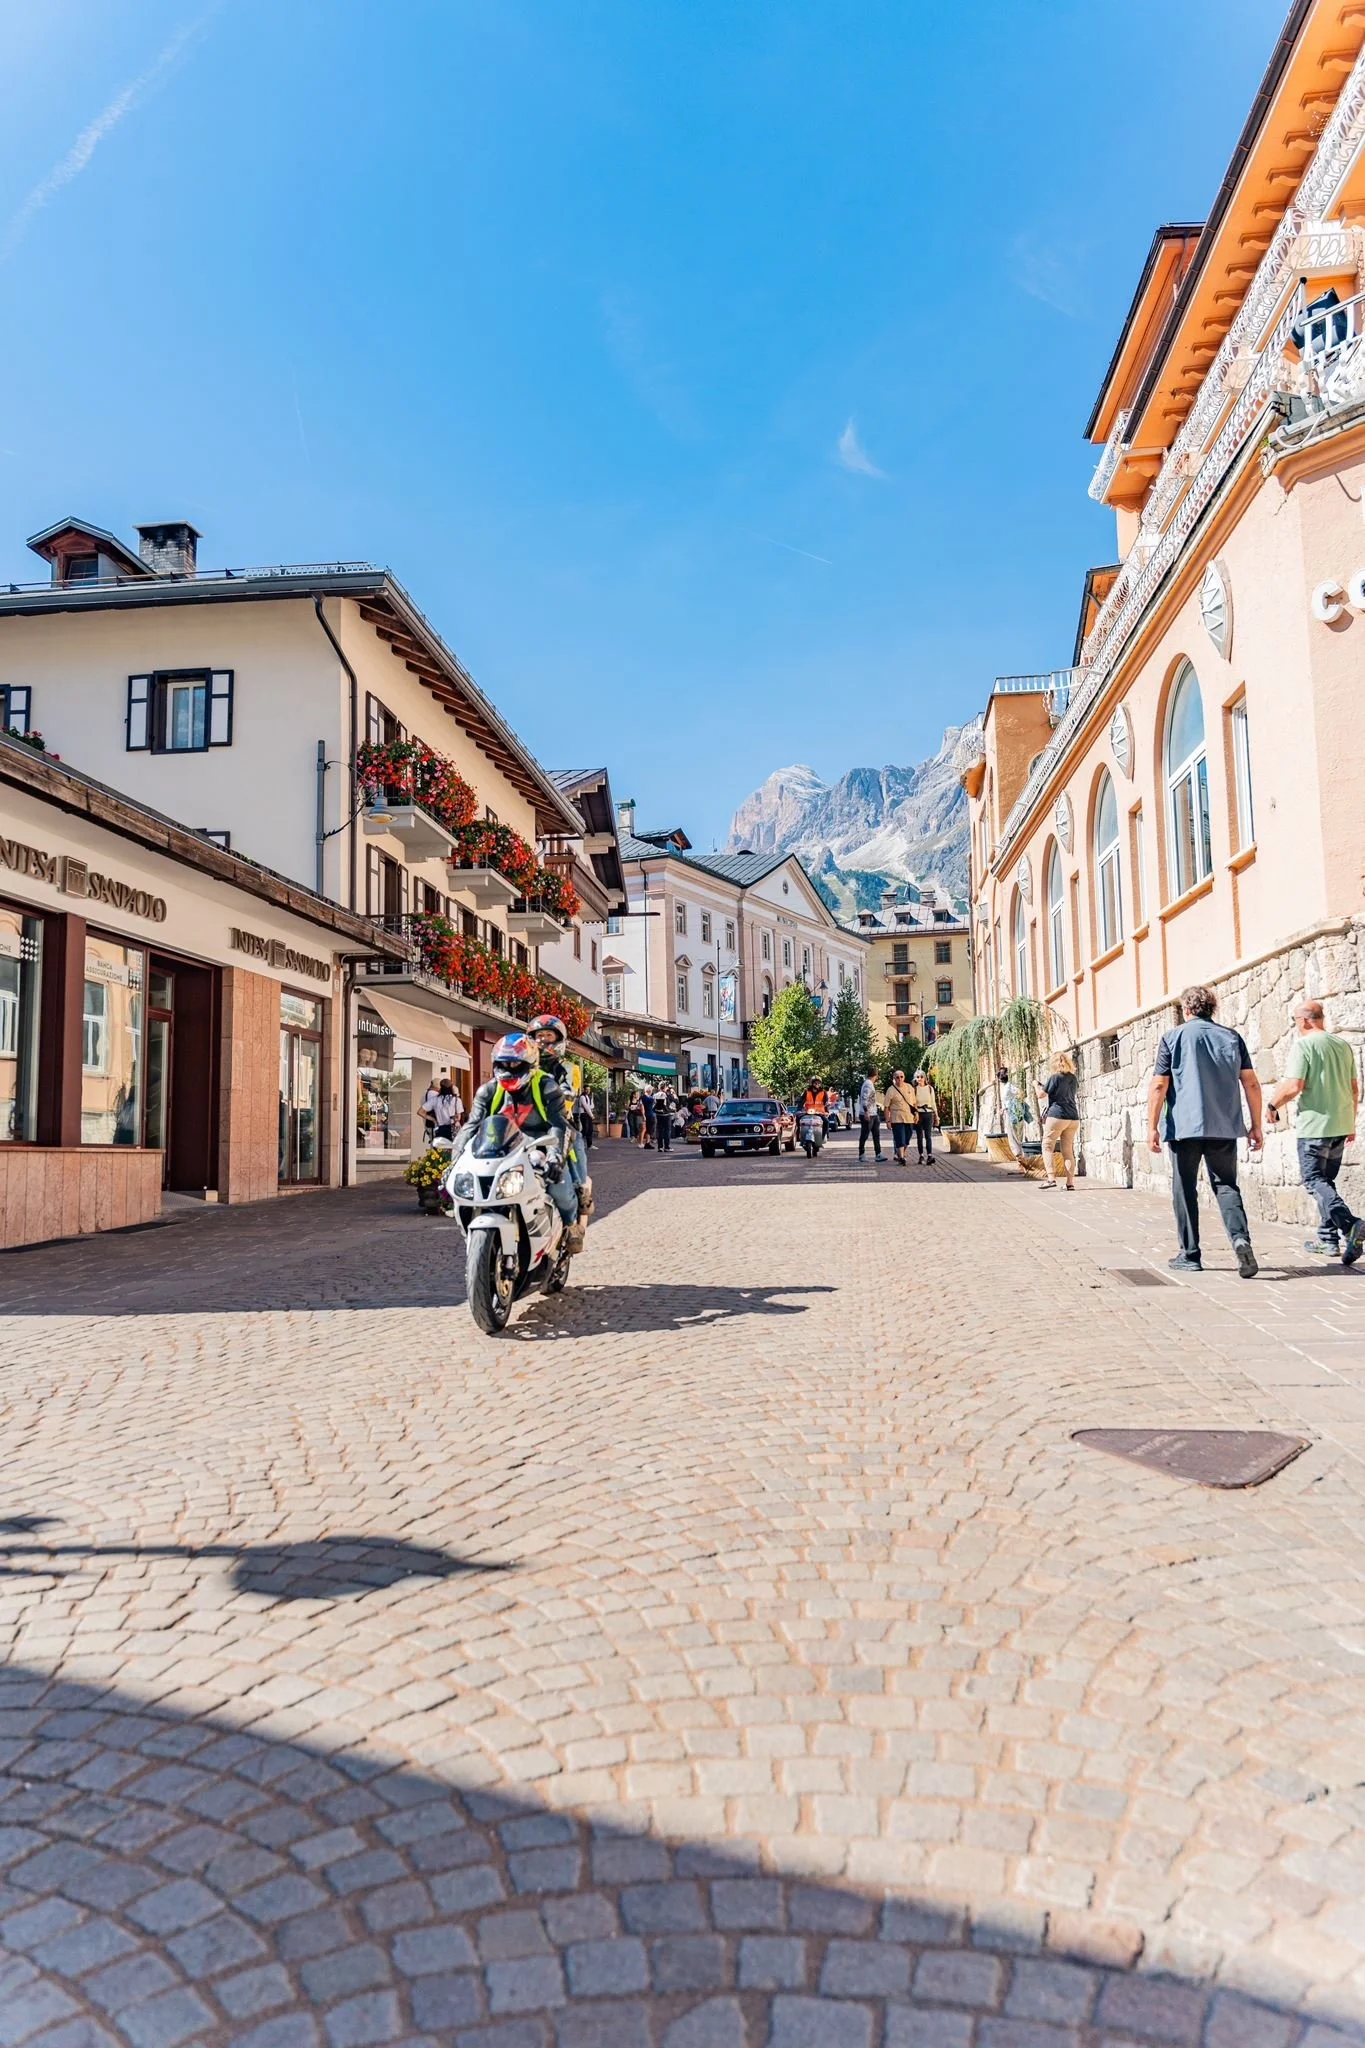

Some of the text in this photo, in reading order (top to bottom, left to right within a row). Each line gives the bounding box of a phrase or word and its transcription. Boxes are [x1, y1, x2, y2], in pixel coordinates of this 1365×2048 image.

[0, 835, 167, 923] NTESA SANPAOLO
[284, 948, 331, 982] SANPAOLO
